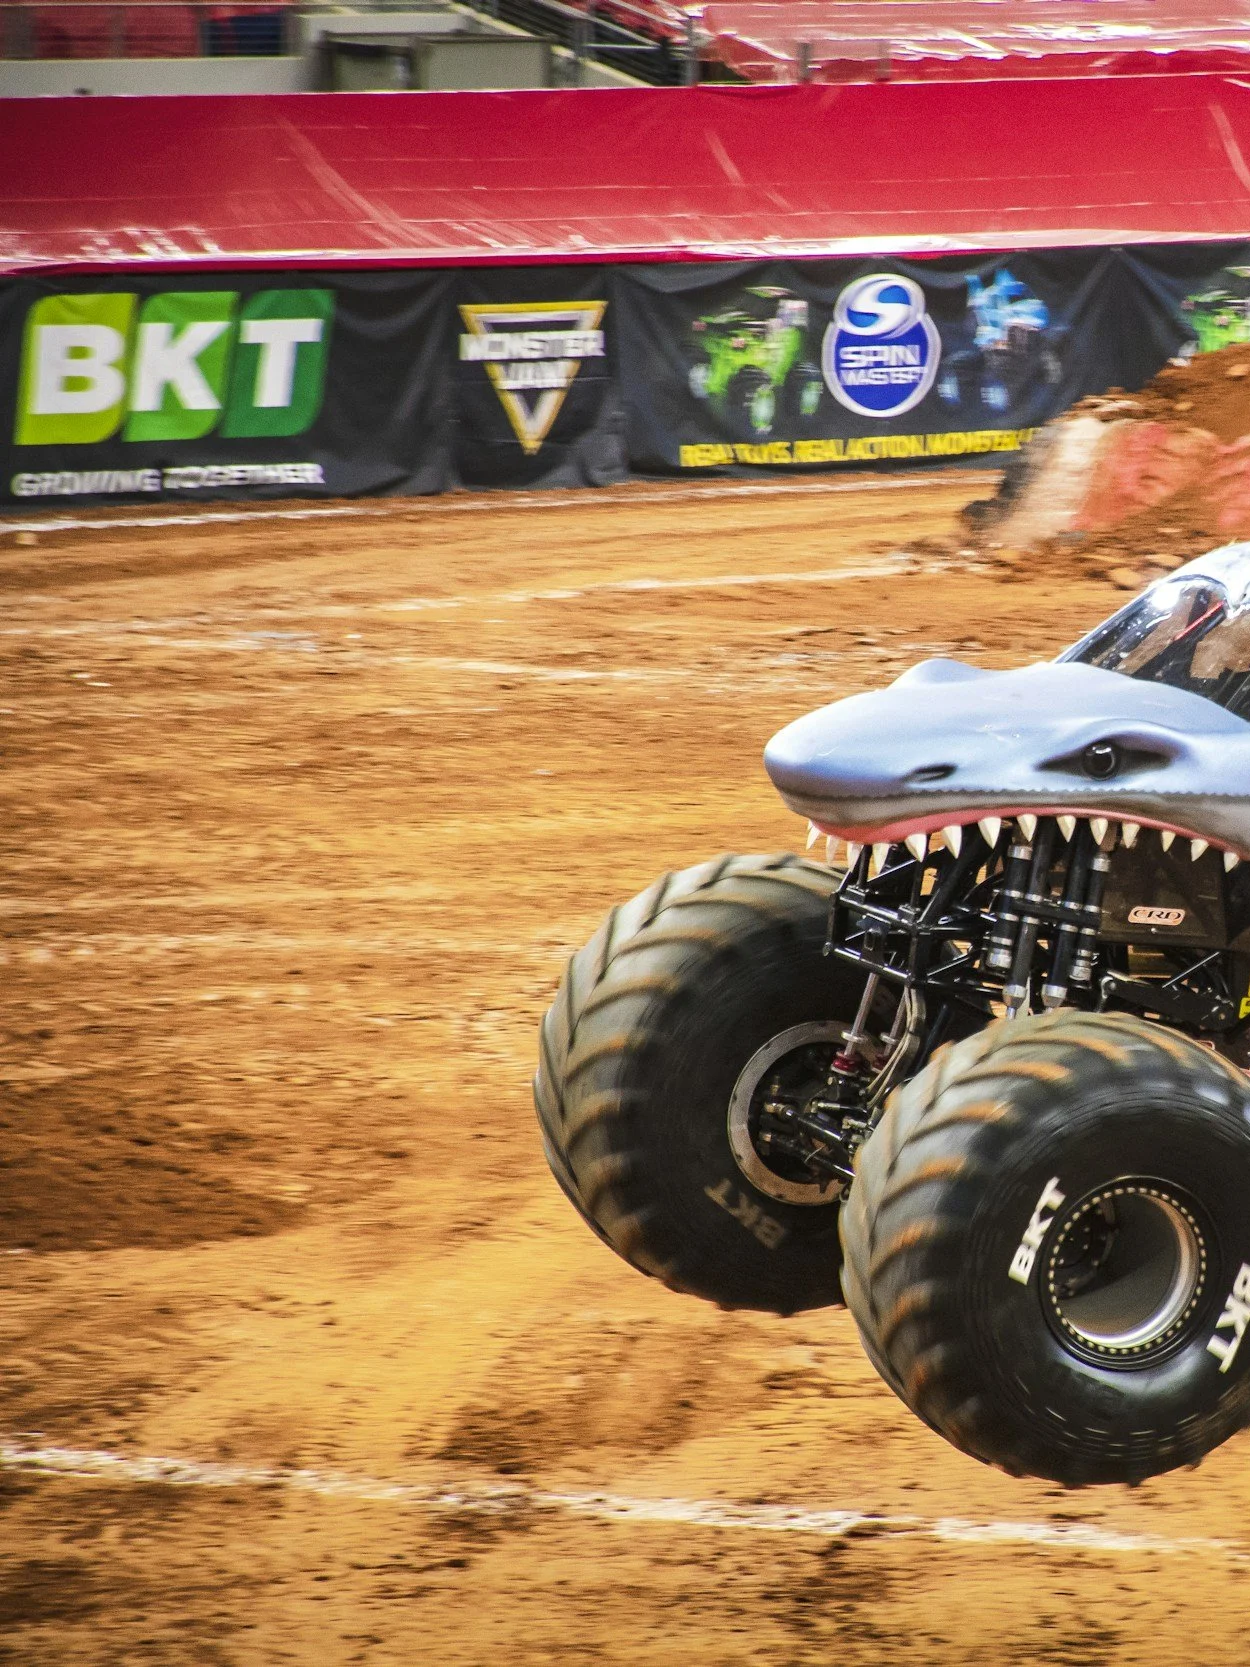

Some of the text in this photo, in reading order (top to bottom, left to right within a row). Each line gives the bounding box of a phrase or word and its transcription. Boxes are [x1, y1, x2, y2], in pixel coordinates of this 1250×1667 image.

[459, 330, 606, 361] MONSTER
[840, 345, 920, 368] SPIN
[29, 319, 324, 414] BKT
[840, 366, 926, 386] MASTER
[10, 463, 325, 497] GROWING TOGETHER
[1008, 1176, 1066, 1285] BKT
